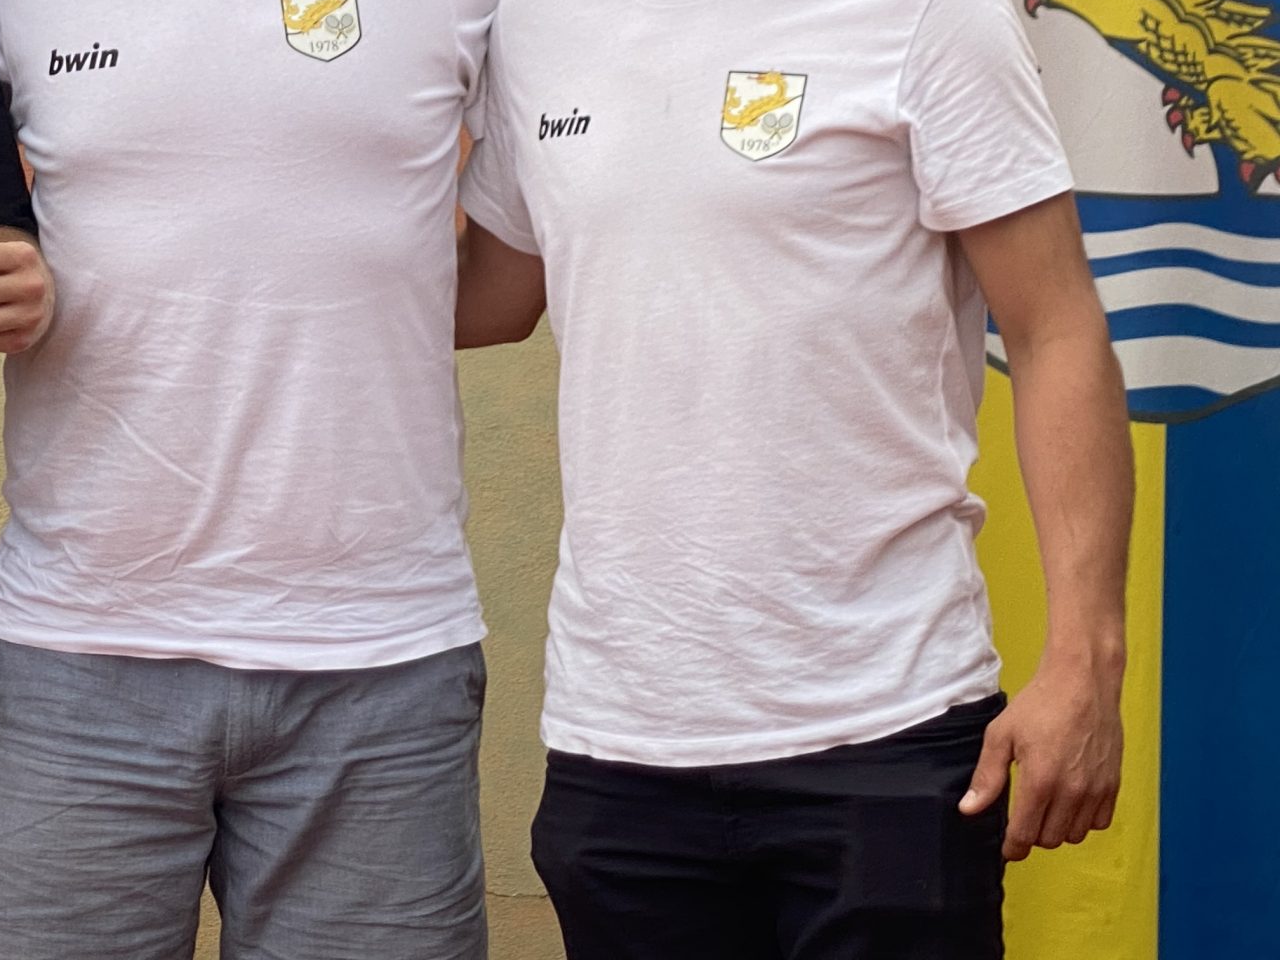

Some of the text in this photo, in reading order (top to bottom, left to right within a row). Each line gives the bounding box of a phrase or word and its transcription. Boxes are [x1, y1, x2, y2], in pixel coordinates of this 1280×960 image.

[310, 40, 339, 53] 1978
[48, 42, 119, 76] bwin
[539, 107, 591, 141] bwin
[740, 139, 770, 152] 1978
